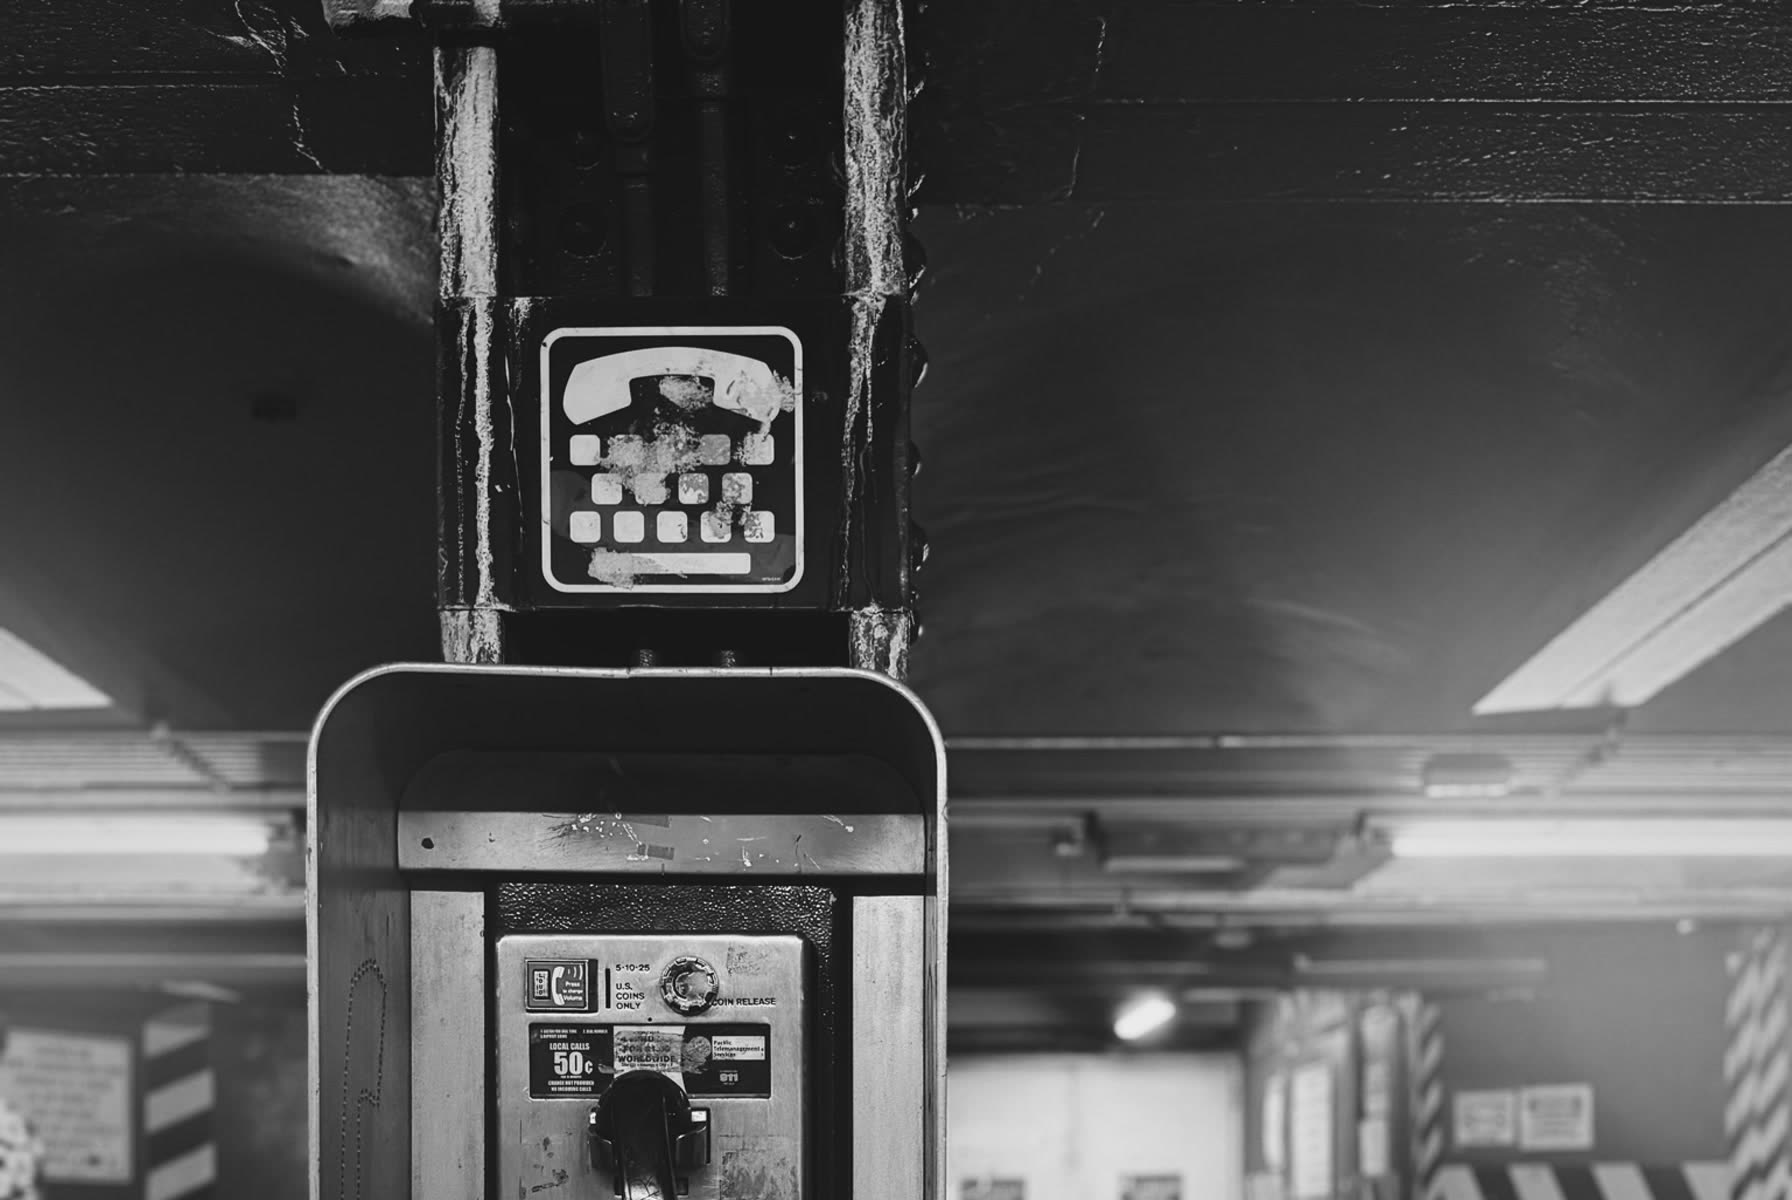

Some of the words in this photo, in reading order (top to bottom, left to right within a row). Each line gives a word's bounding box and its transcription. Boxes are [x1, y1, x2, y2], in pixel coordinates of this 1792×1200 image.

[616, 982, 633, 990] U.S.
[616, 992, 645, 1000] COINS
[554, 1051, 593, 1075] 50¢
[720, 1073, 738, 1082] 911
